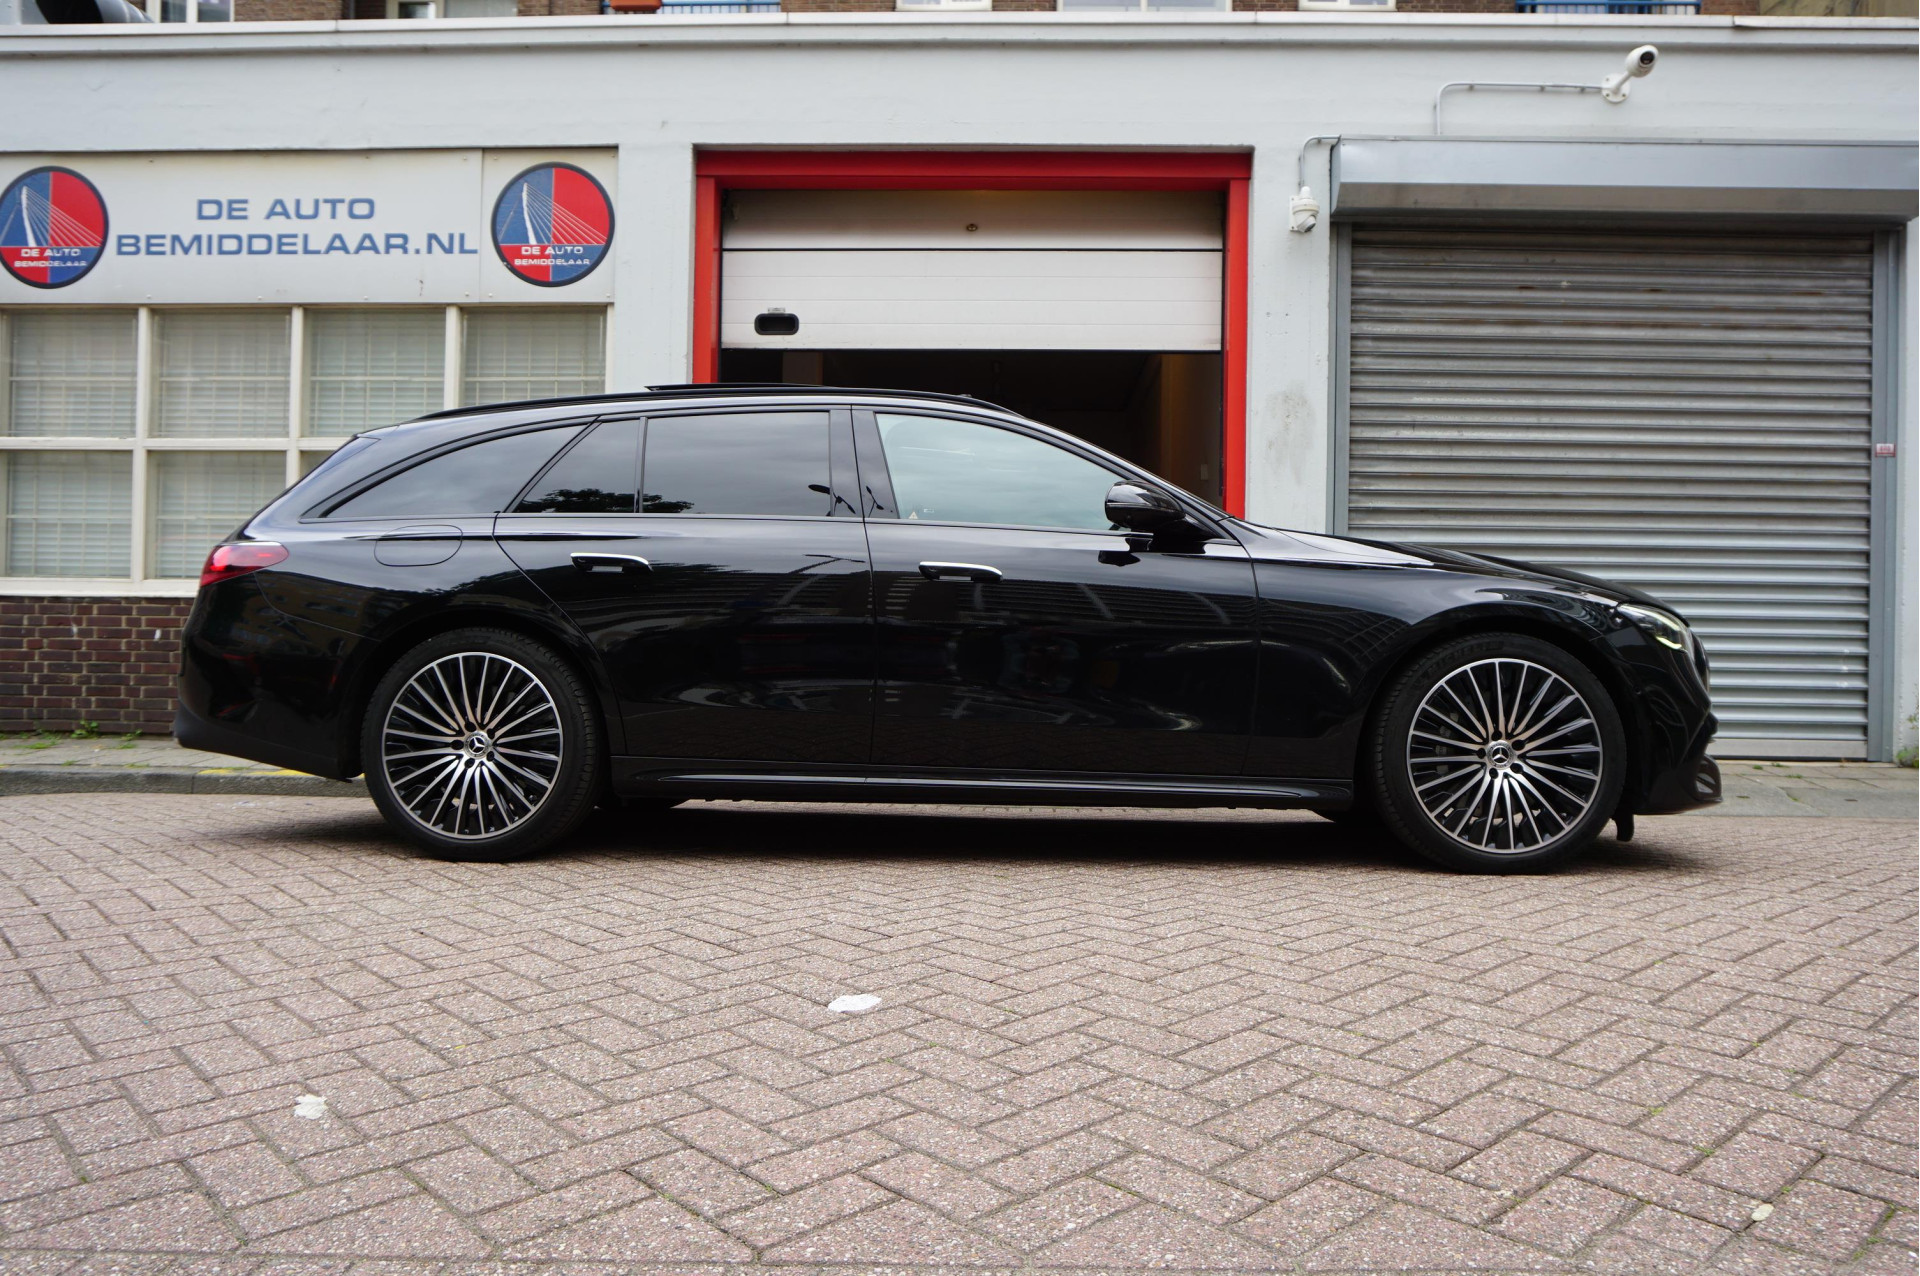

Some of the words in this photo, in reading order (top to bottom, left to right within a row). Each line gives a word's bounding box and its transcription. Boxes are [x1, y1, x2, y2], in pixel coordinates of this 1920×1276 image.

[197, 199, 248, 220] DE
[264, 198, 375, 220] AUTO
[116, 233, 478, 255] BEMIDDELAAR.NL
[521, 246, 540, 255] DE
[544, 246, 583, 255] AUTO
[21, 248, 40, 257] DE
[43, 248, 81, 257] AUTO
